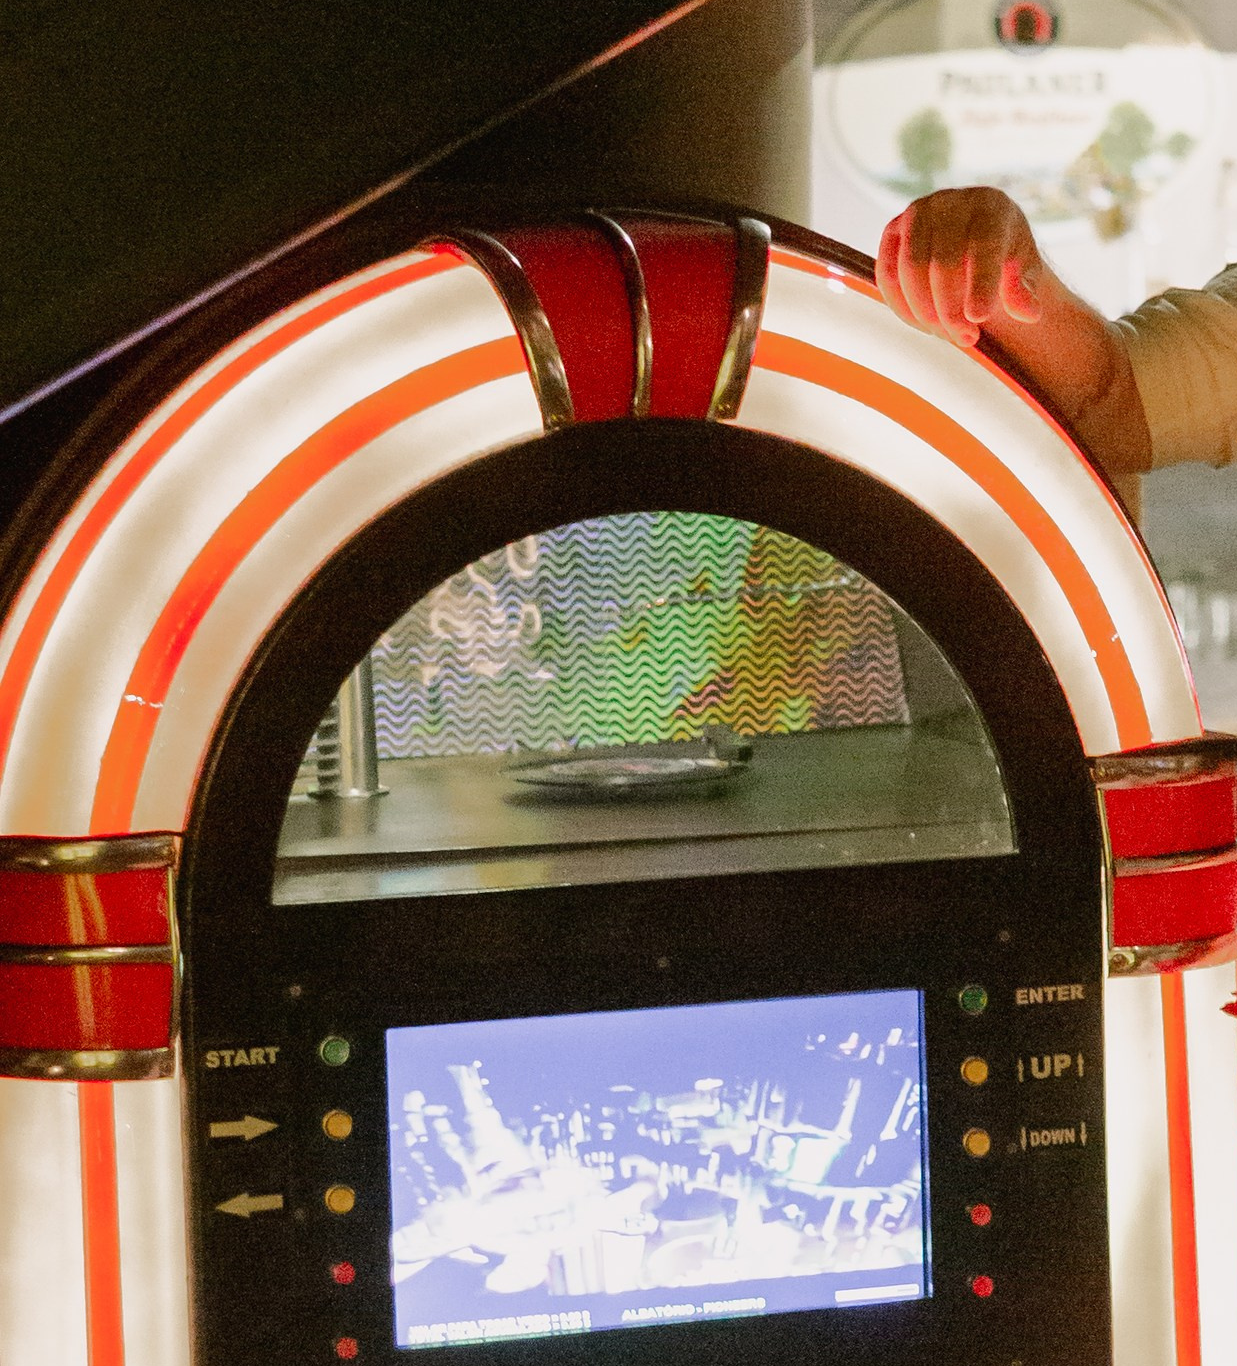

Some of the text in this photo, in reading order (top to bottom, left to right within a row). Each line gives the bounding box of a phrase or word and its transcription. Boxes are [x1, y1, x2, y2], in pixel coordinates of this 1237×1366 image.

[1016, 984, 1085, 1006] ENTER
[205, 1046, 280, 1069] START
[1030, 1053, 1073, 1080] UP
[1030, 1126, 1075, 1146] DOWN
